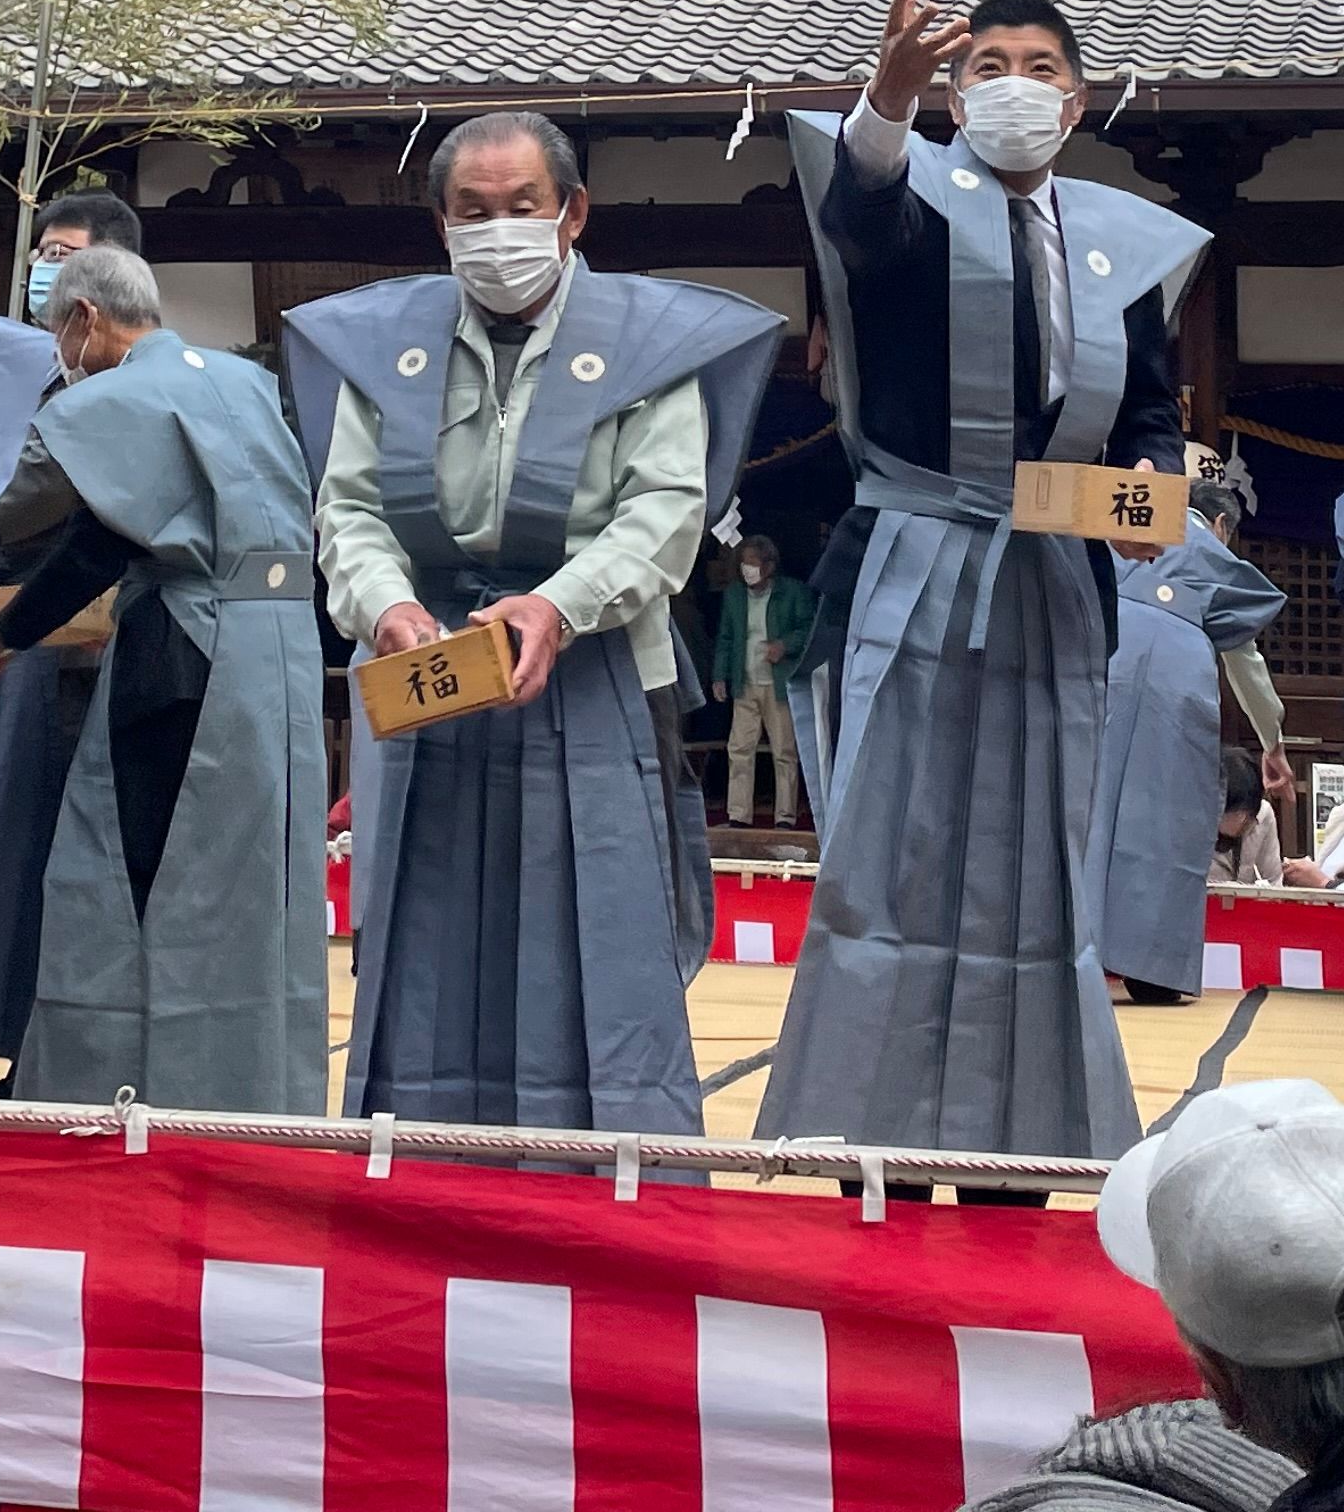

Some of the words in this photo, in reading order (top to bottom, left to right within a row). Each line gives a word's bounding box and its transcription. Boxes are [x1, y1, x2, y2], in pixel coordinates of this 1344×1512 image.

[1197, 453, 1226, 484] 節
[1109, 482, 1154, 528] 福
[404, 652, 460, 706] 福
